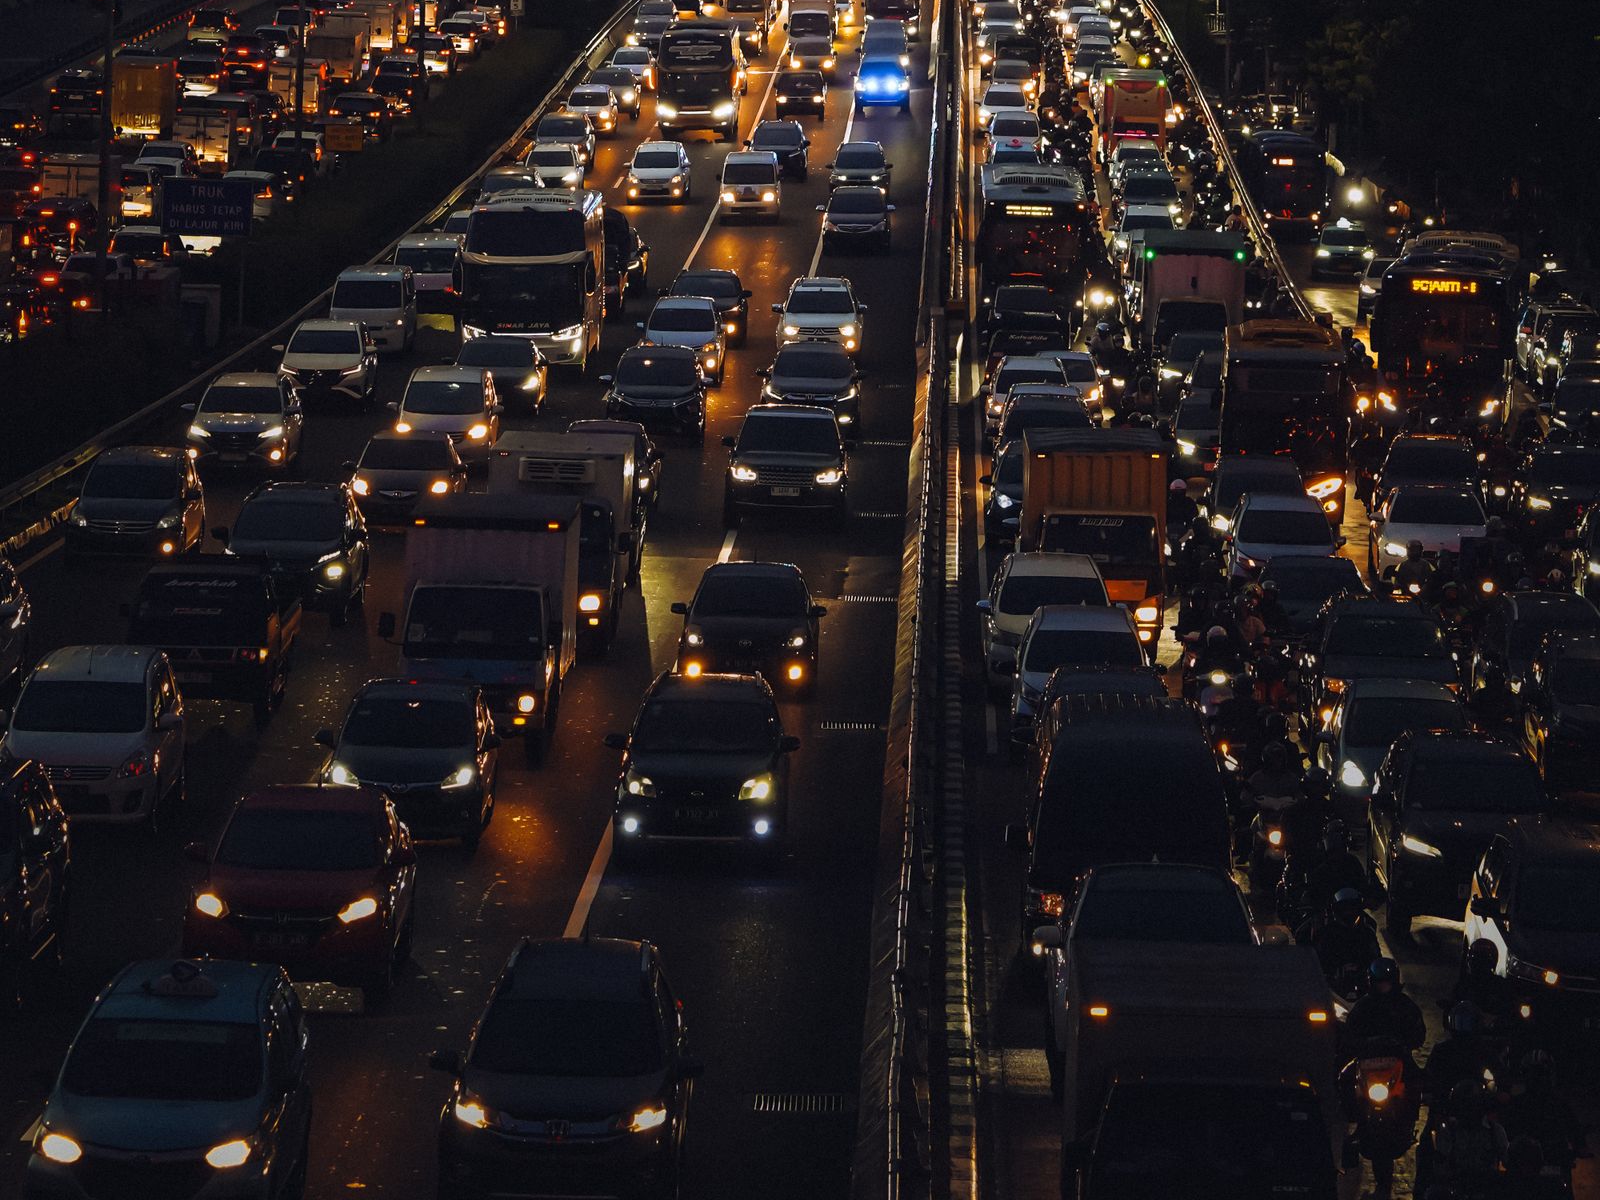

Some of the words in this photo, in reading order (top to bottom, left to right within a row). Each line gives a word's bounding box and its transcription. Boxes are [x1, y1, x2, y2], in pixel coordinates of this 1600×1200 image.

[190, 185, 225, 199] TRUK
[172, 203, 206, 214] HARUS
[213, 205, 243, 216] TETAP
[170, 219, 180, 228] DI
[185, 220, 218, 229] LAJUR
[224, 222, 244, 231] KIRI
